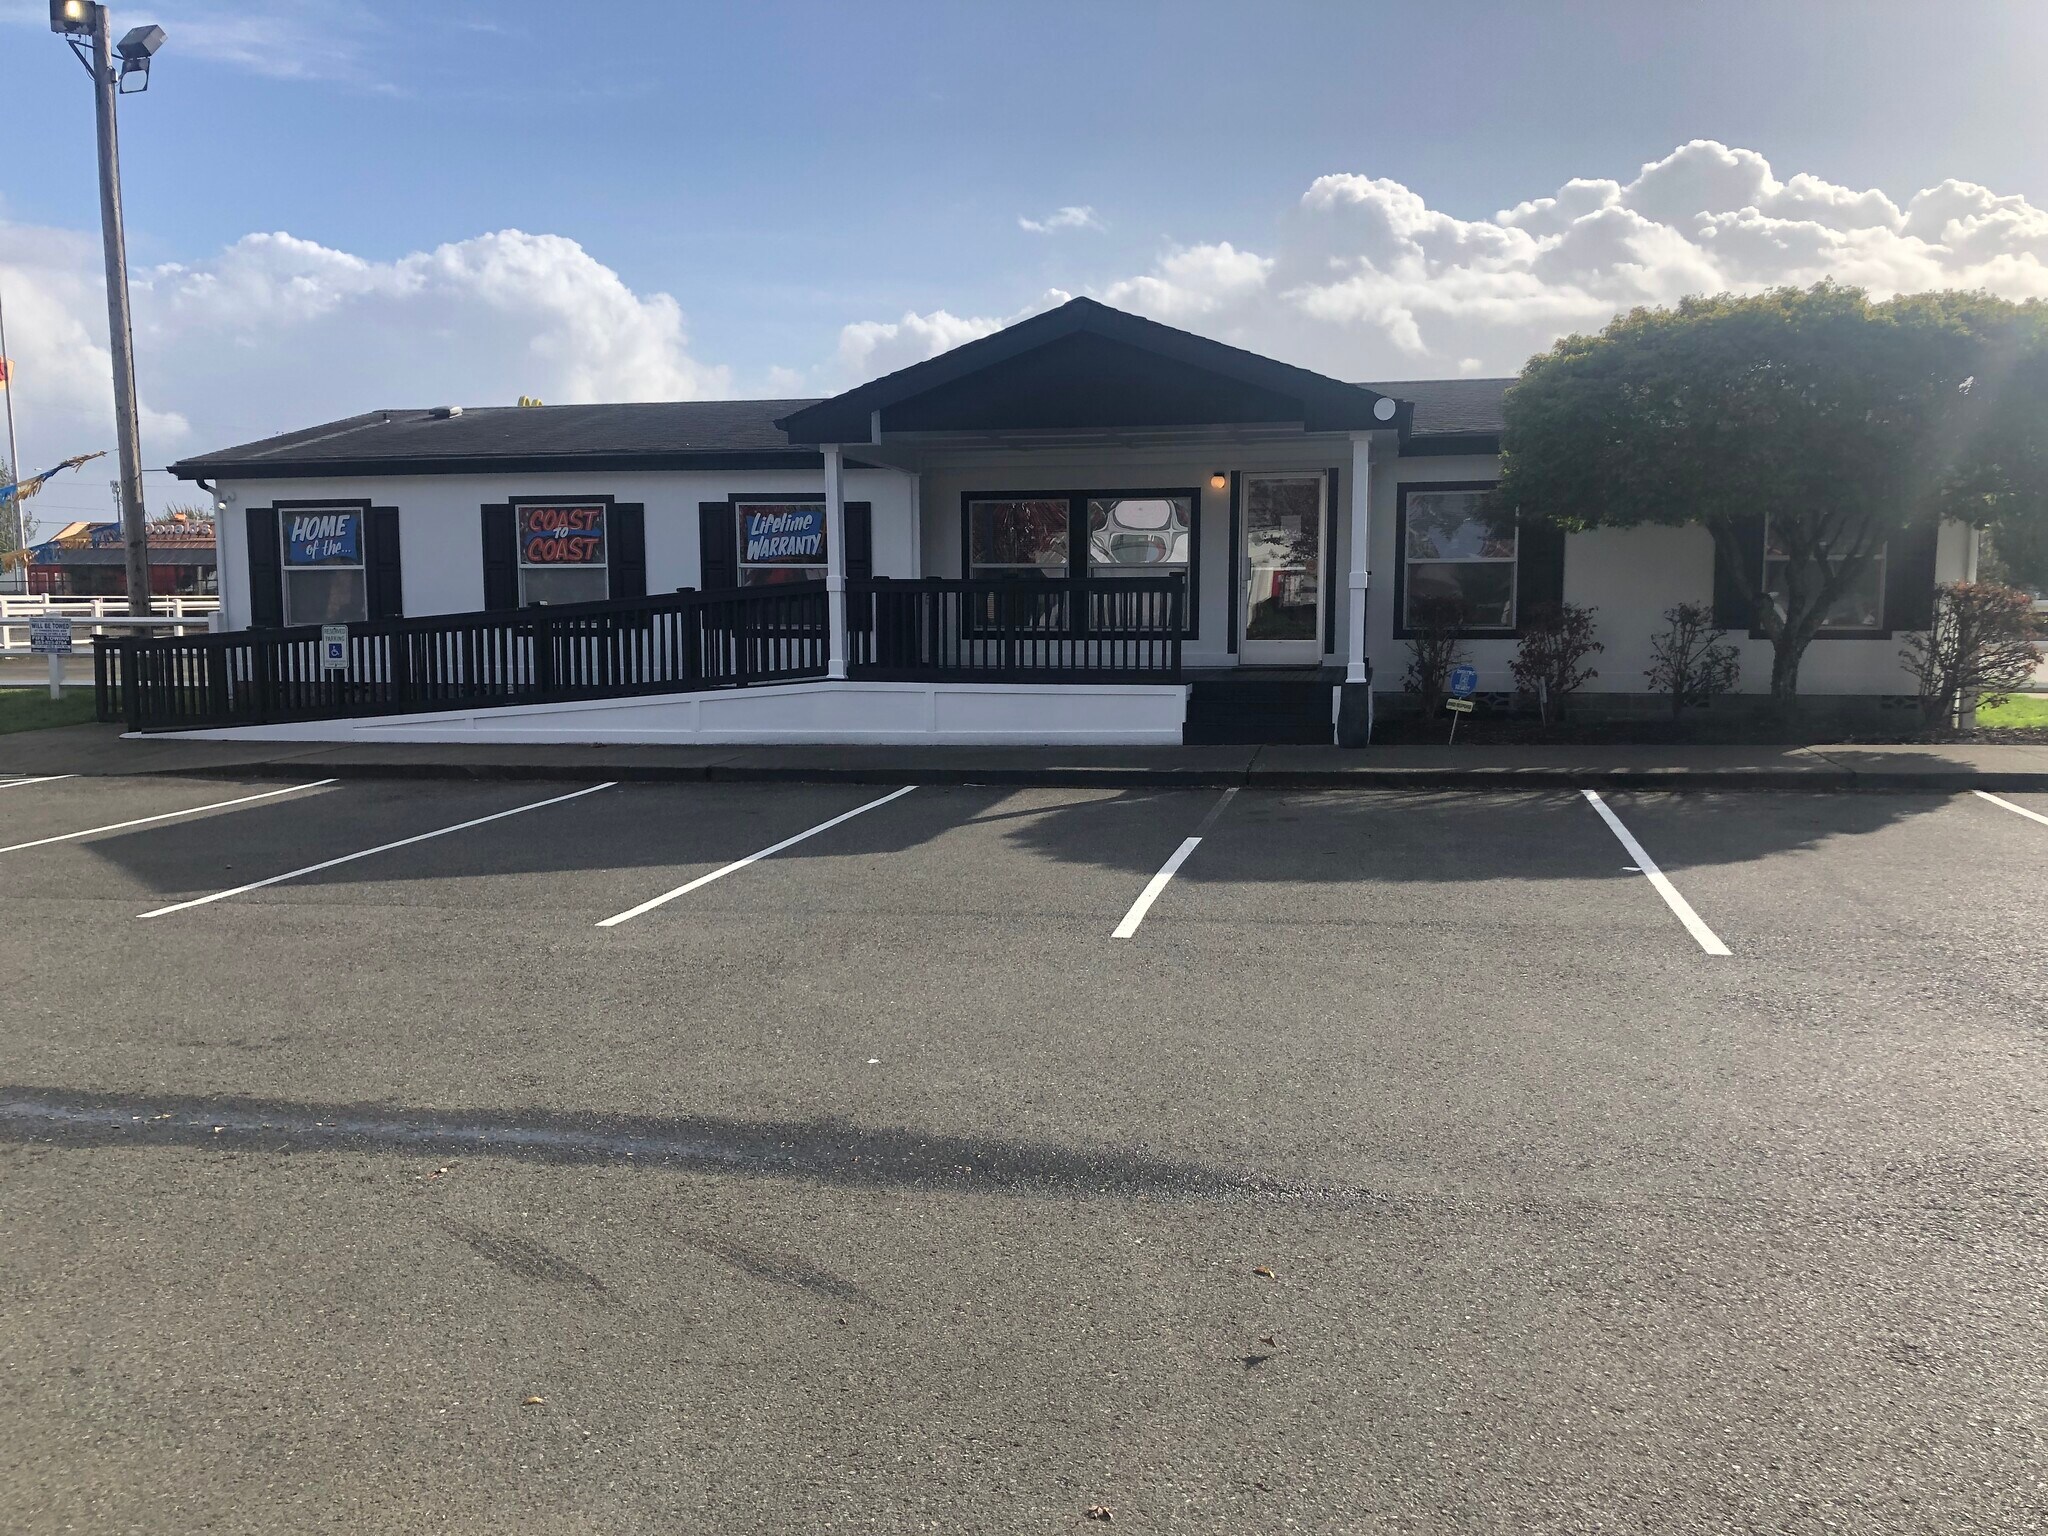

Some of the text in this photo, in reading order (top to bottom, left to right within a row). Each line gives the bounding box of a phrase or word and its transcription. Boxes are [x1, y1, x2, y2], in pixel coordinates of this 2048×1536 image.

[145, 521, 212, 535] Donald's
[291, 514, 350, 542] HOME
[529, 508, 600, 532] COAST
[751, 512, 813, 536] Lifetime
[305, 540, 319, 559] of
[527, 537, 600, 561] COAST
[746, 533, 822, 560] WARRANTY
